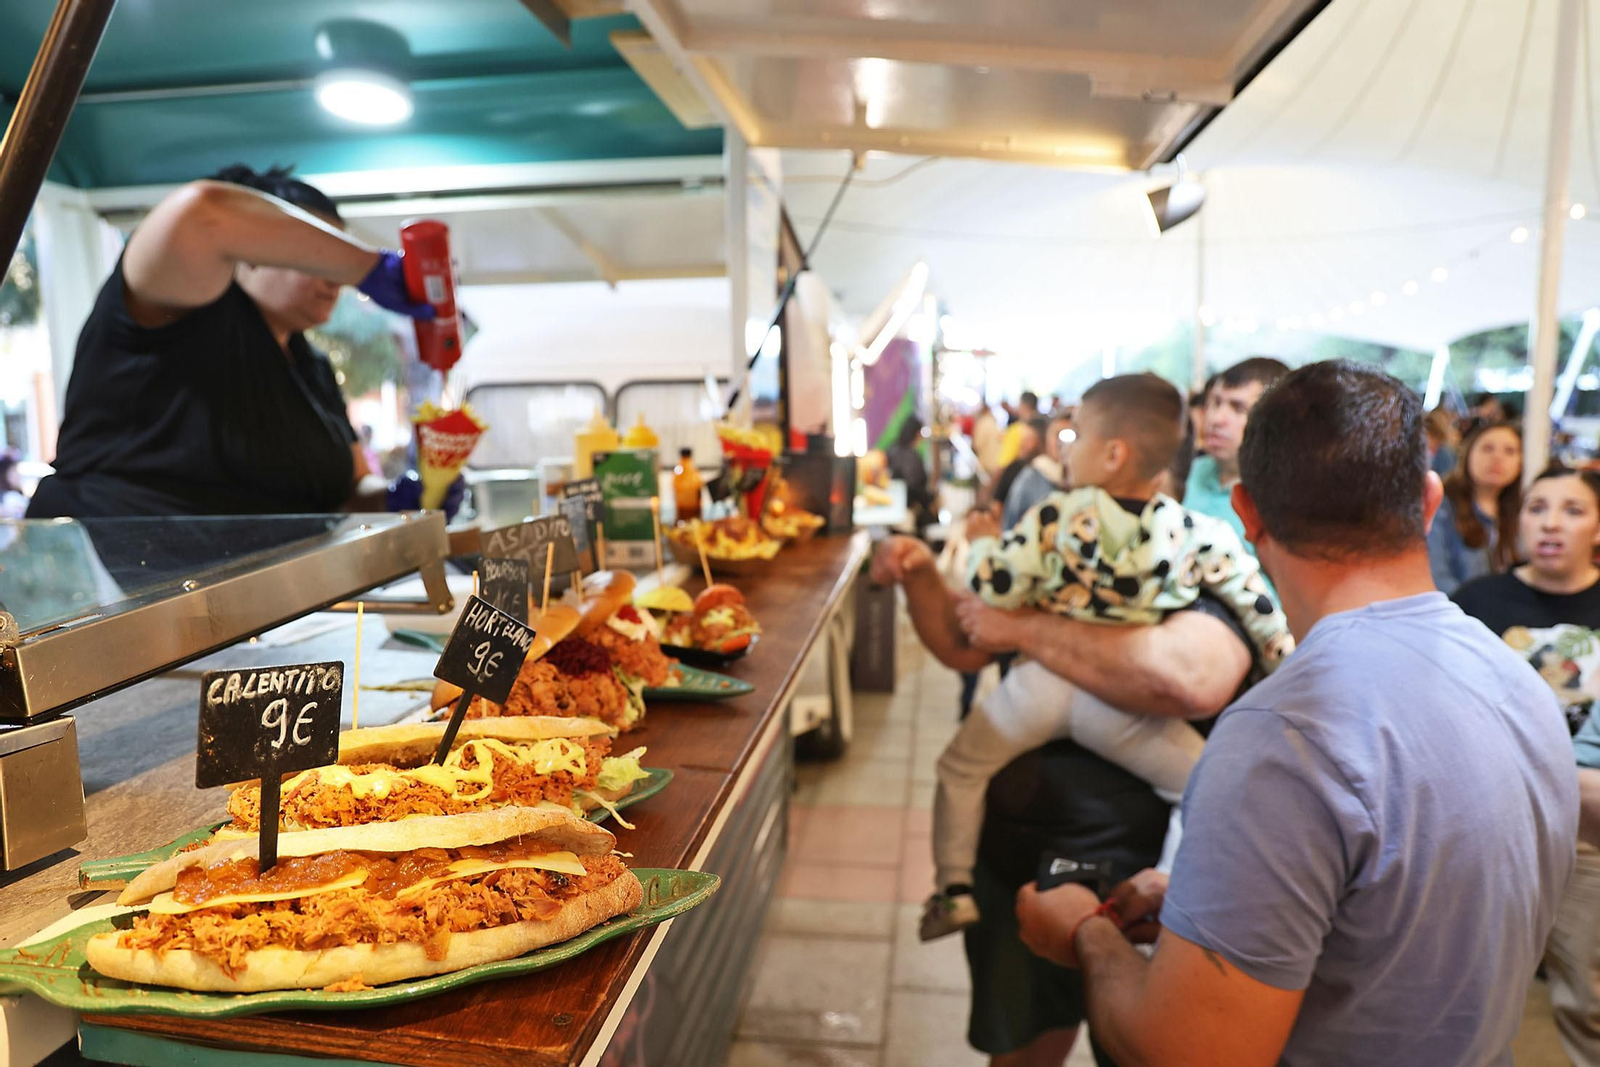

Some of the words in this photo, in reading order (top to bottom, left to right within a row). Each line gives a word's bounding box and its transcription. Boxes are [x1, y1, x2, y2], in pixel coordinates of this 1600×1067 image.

[464, 601, 534, 653] HORTELANO
[467, 641, 504, 677] 9€
[206, 665, 341, 706] CALENTITO
[261, 697, 318, 749] 9€
